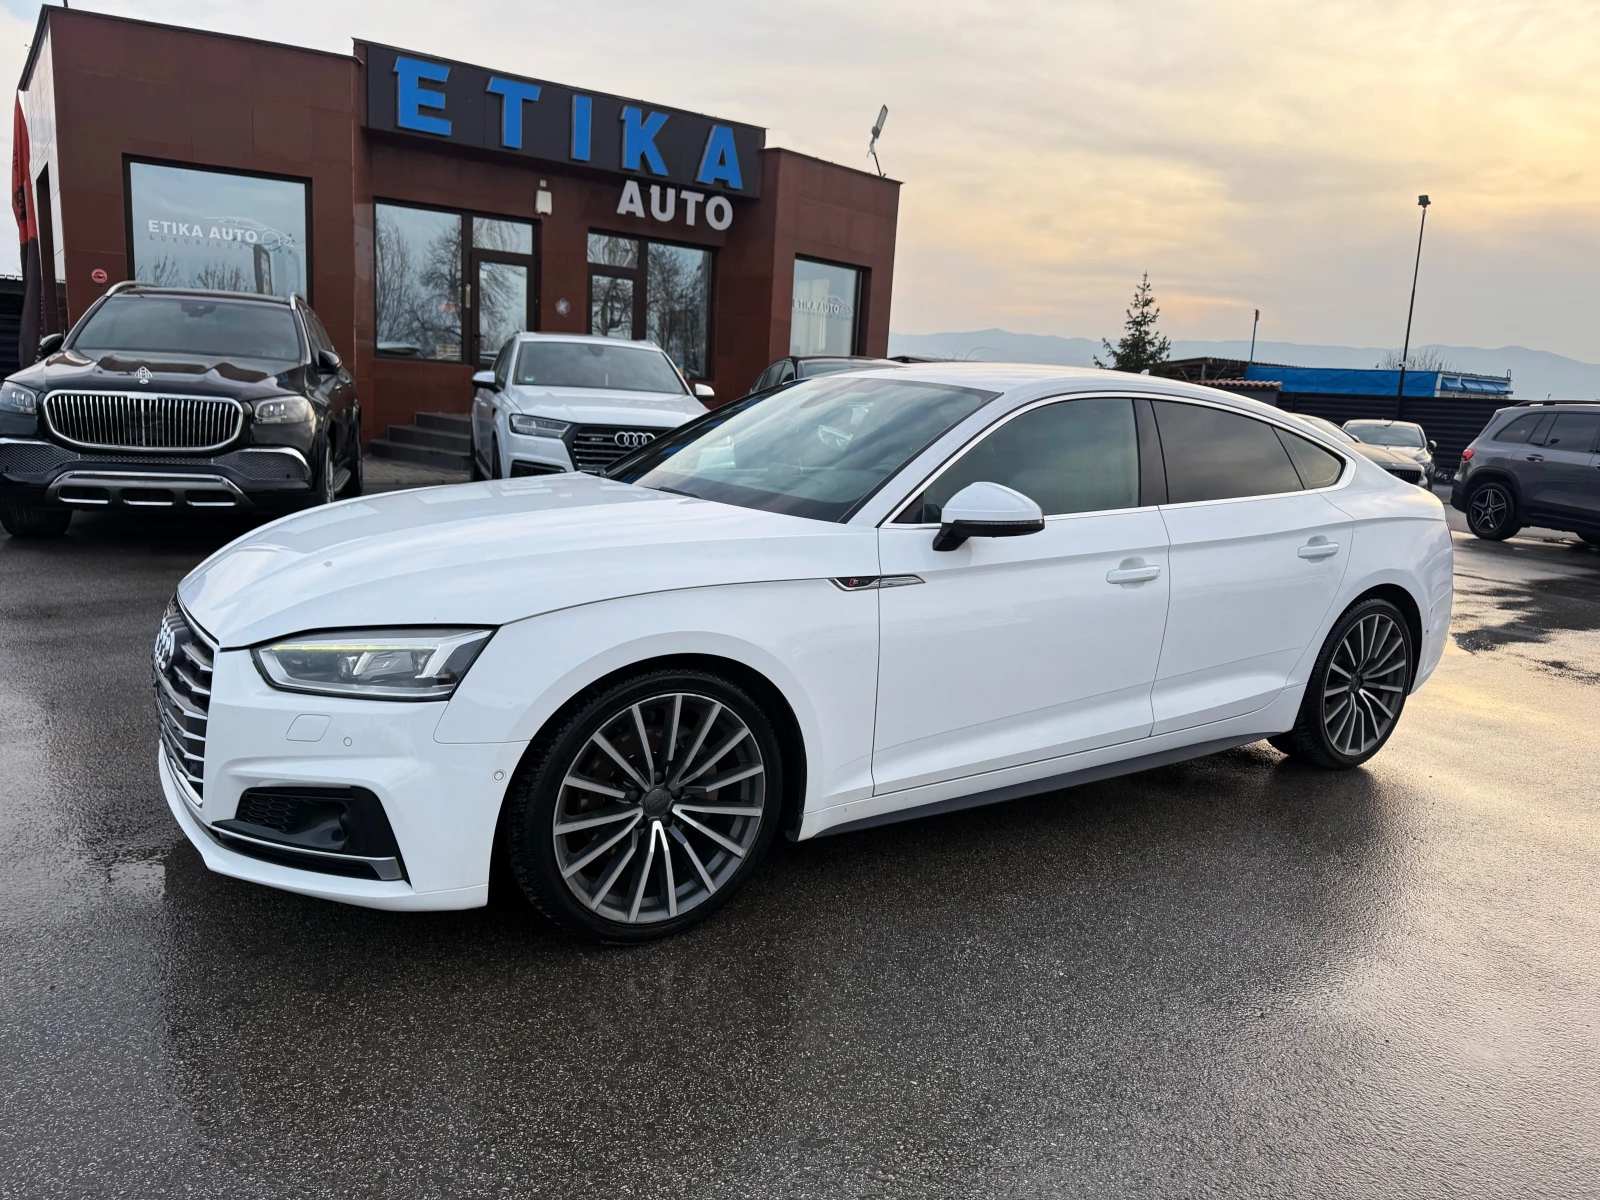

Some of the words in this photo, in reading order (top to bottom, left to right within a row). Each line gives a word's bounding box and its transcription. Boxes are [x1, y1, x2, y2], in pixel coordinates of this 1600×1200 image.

[393, 56, 744, 191] ETIKA
[616, 180, 734, 231] AUTO
[148, 219, 203, 238] ETIKA
[209, 226, 258, 243] AUTO
[794, 298, 817, 311] ETIKA
[817, 301, 840, 314] AUTO
